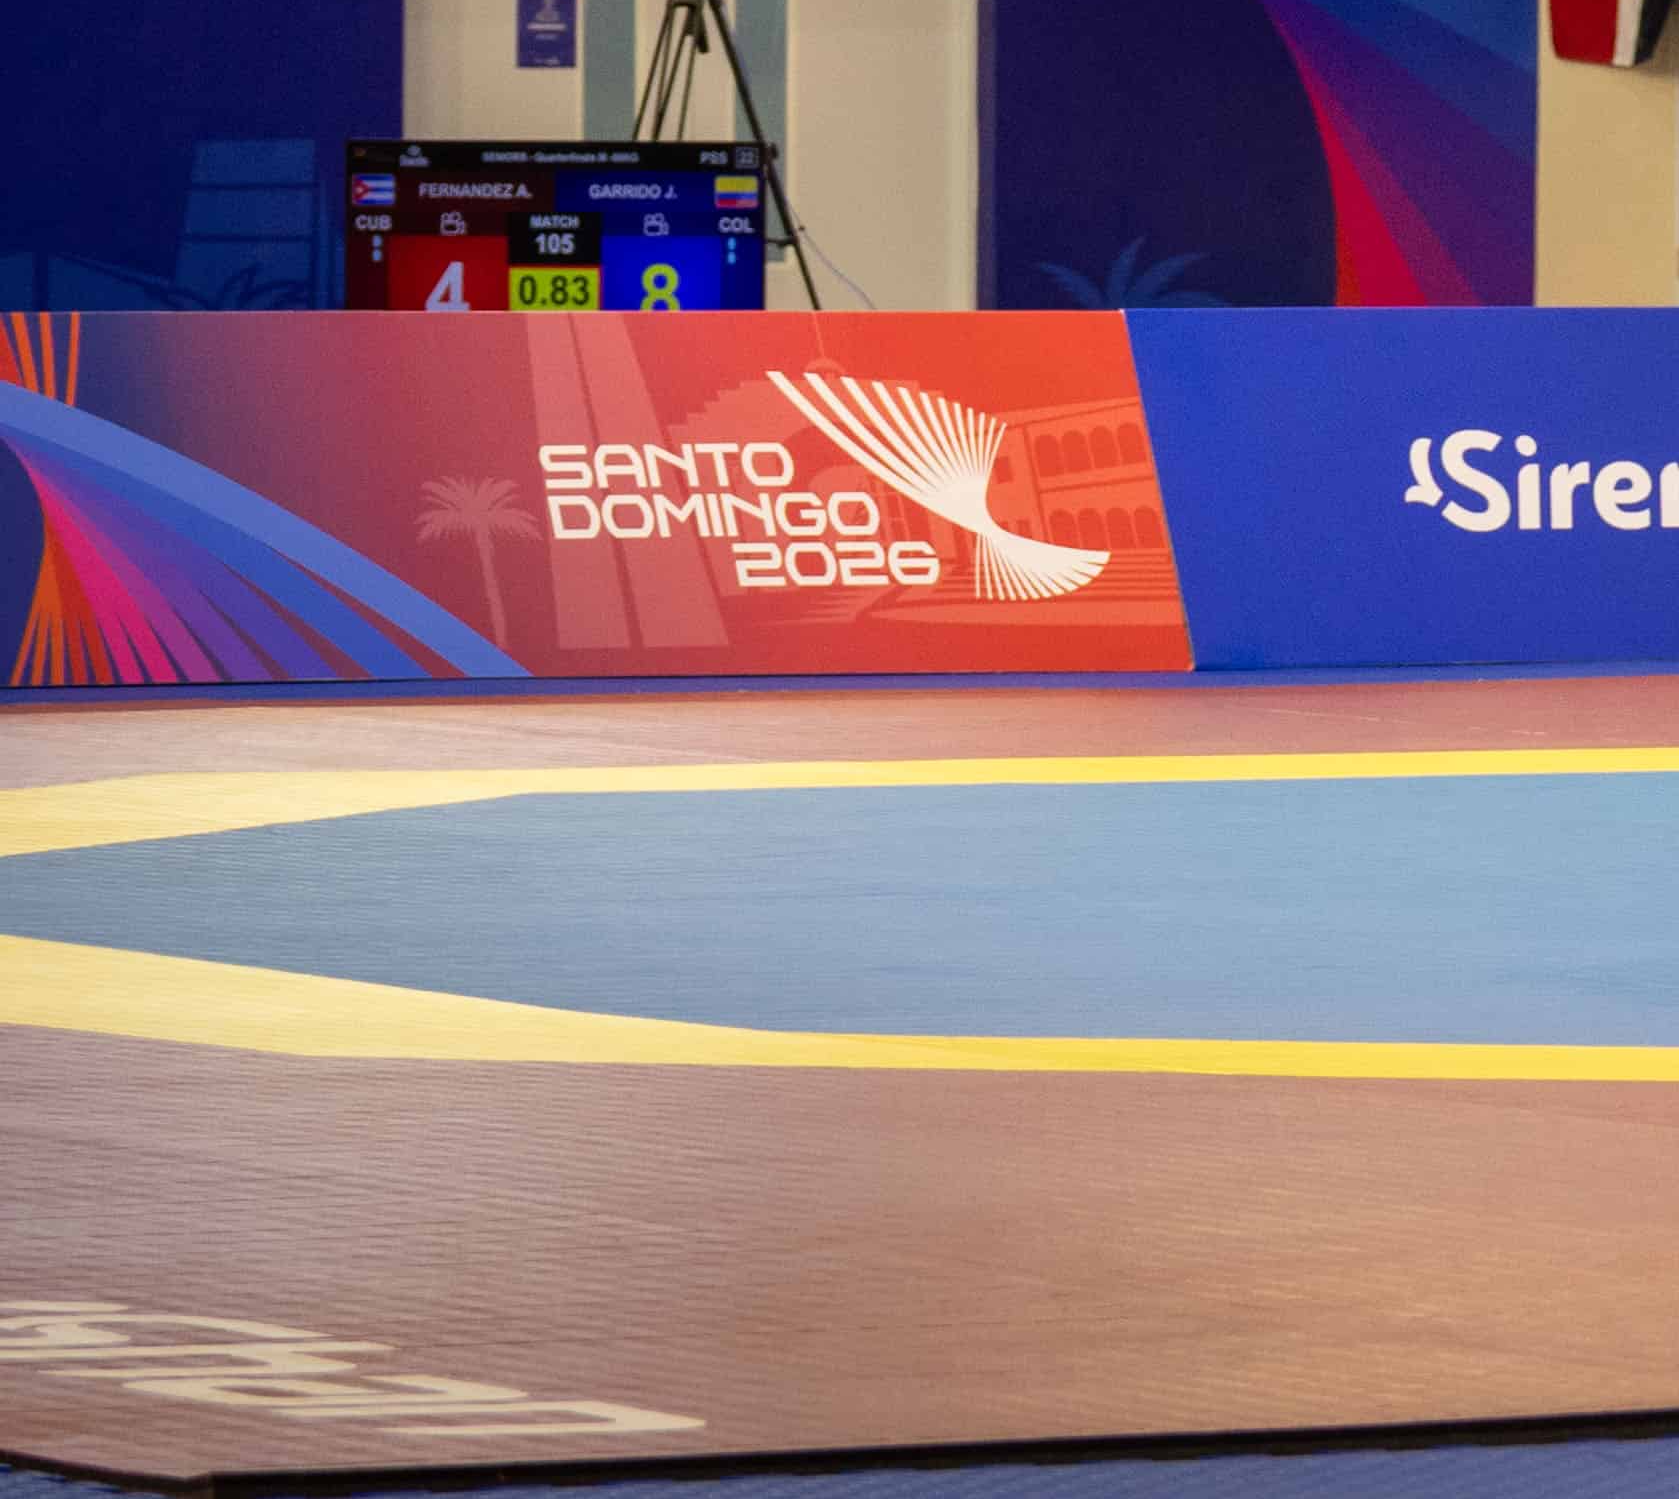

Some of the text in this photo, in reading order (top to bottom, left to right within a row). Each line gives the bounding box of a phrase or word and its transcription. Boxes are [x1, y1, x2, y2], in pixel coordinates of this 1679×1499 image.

[419, 183, 512, 198] FERNANDEZ
[588, 184, 661, 199] GARRIDO
[355, 215, 392, 231] CUB
[531, 215, 579, 229] MATCH
[718, 217, 753, 233] COL
[536, 234, 575, 255] 105
[425, 261, 471, 310] 4
[519, 275, 590, 306] 0.83
[539, 442, 796, 490] SANTO
[546, 491, 881, 540] DOMINGO
[731, 541, 941, 588] 2026
